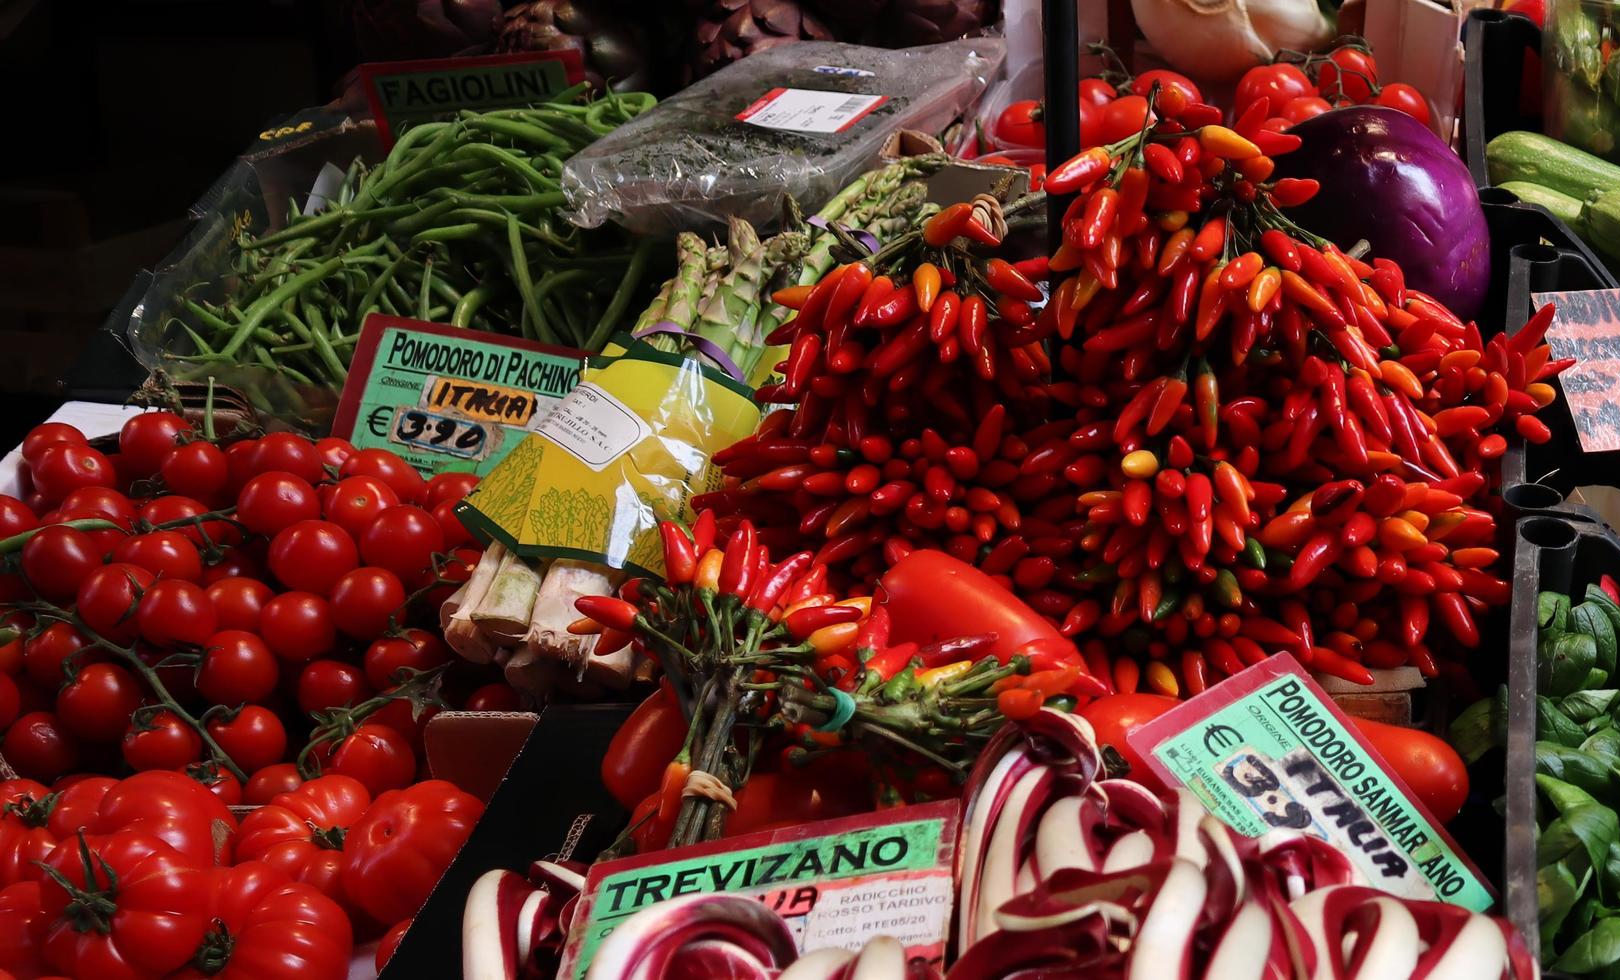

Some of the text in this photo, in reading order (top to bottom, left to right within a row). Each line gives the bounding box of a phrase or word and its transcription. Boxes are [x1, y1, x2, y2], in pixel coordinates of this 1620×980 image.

[381, 69, 549, 107] FAGIOLINI
[388, 331, 483, 379] POMODORO
[503, 352, 580, 394] PACHINO
[381, 375, 530, 420] ORIGINE ITALIA
[367, 405, 484, 449] € 3.90
[1203, 723, 1245, 757] €
[1247, 705, 1293, 752] ORIGINE
[1220, 754, 1313, 829] 3.9
[1266, 680, 1466, 897] POMODORO SANMARANO
[1286, 758, 1410, 878] ITALIA
[606, 835, 908, 912] TREVIZANO
[840, 885, 927, 905] RADICCHIO
[817, 895, 947, 920] ROSSO TARDIVO
